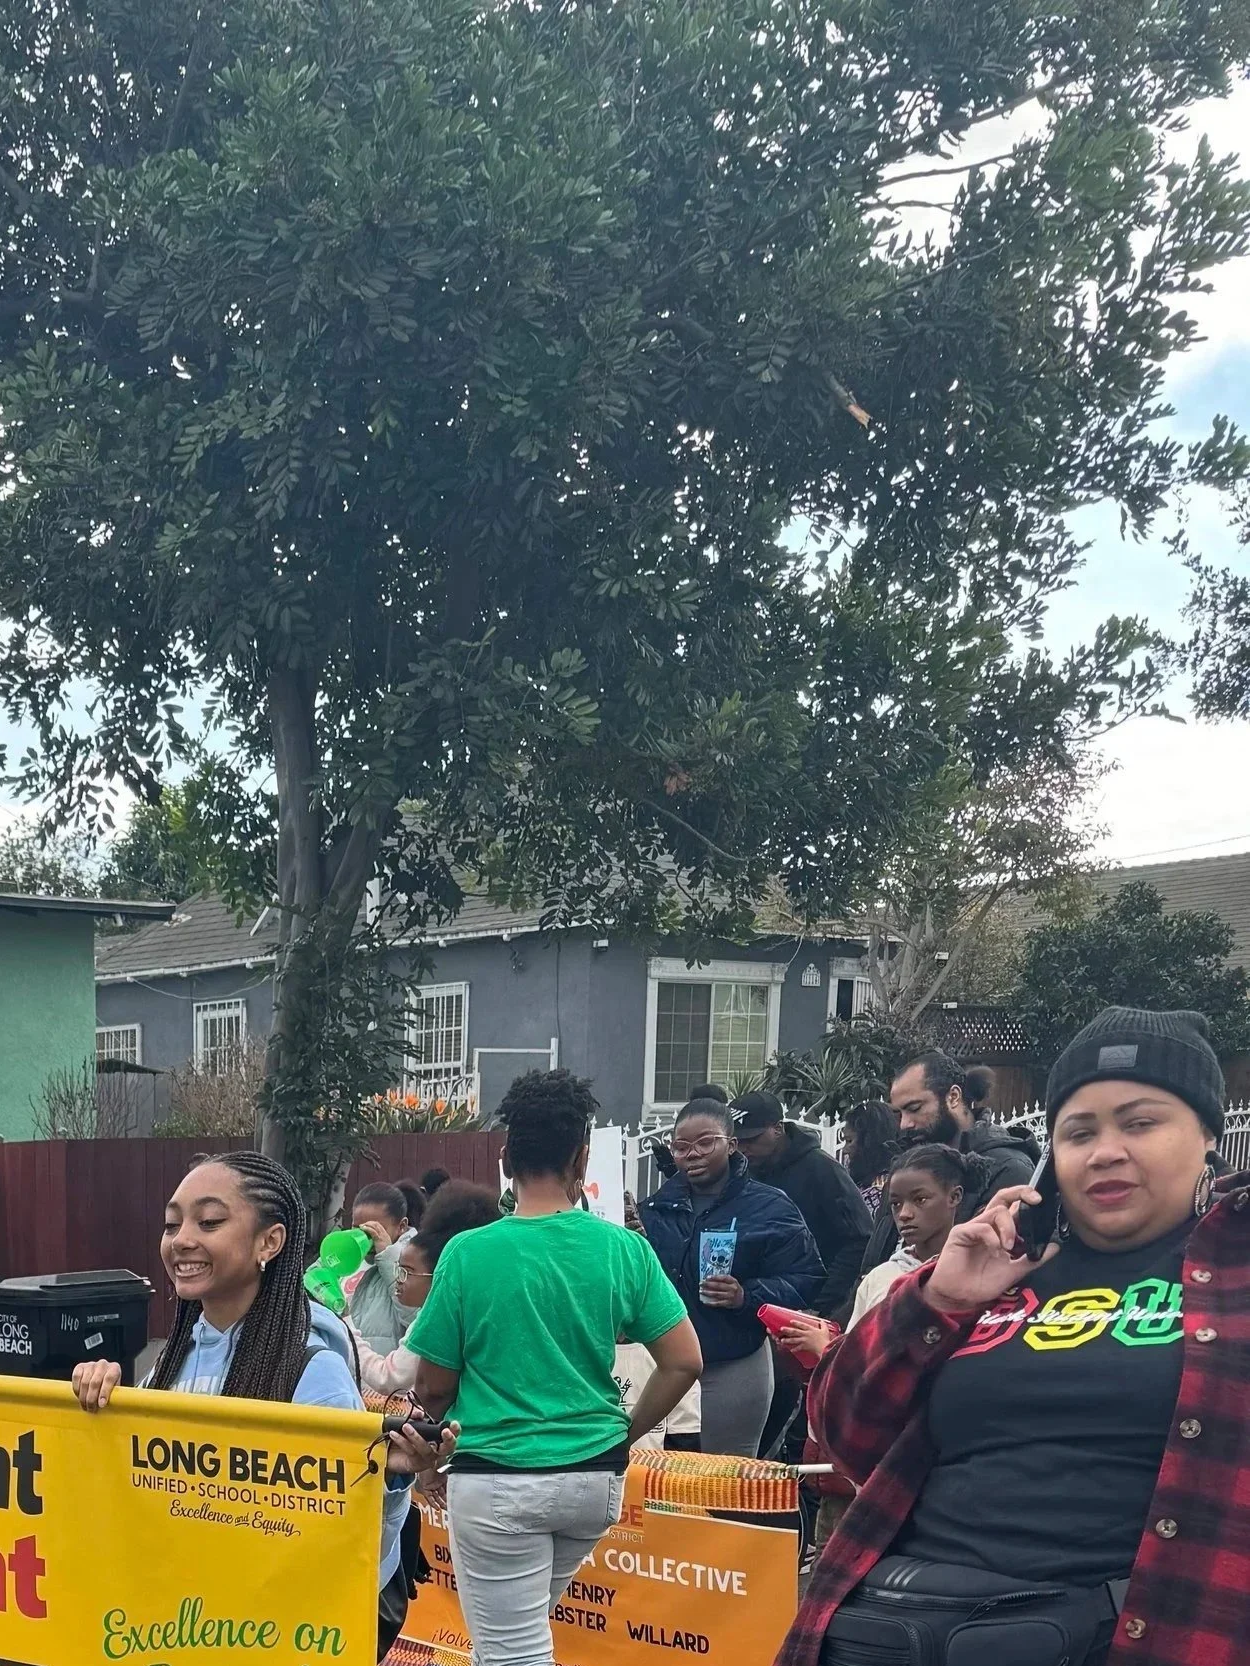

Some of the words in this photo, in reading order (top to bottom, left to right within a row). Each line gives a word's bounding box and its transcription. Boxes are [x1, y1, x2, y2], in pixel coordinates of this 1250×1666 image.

[9, 1314, 18, 1324] OF
[131, 1434, 221, 1478] LONG
[229, 1446, 345, 1494] BEACH
[131, 1473, 188, 1494] UNIFIED
[198, 1482, 261, 1505] SCHOOL
[270, 1492, 346, 1516] DISTRICT
[170, 1499, 234, 1525] Excellence
[234, 1512, 250, 1527] and
[251, 1510, 301, 1538] Equity
[604, 1548, 748, 1597] COLLECTIVE
[102, 1596, 281, 1660] Excellence
[293, 1622, 347, 1657] on
[626, 1619, 710, 1655] WILLARD
